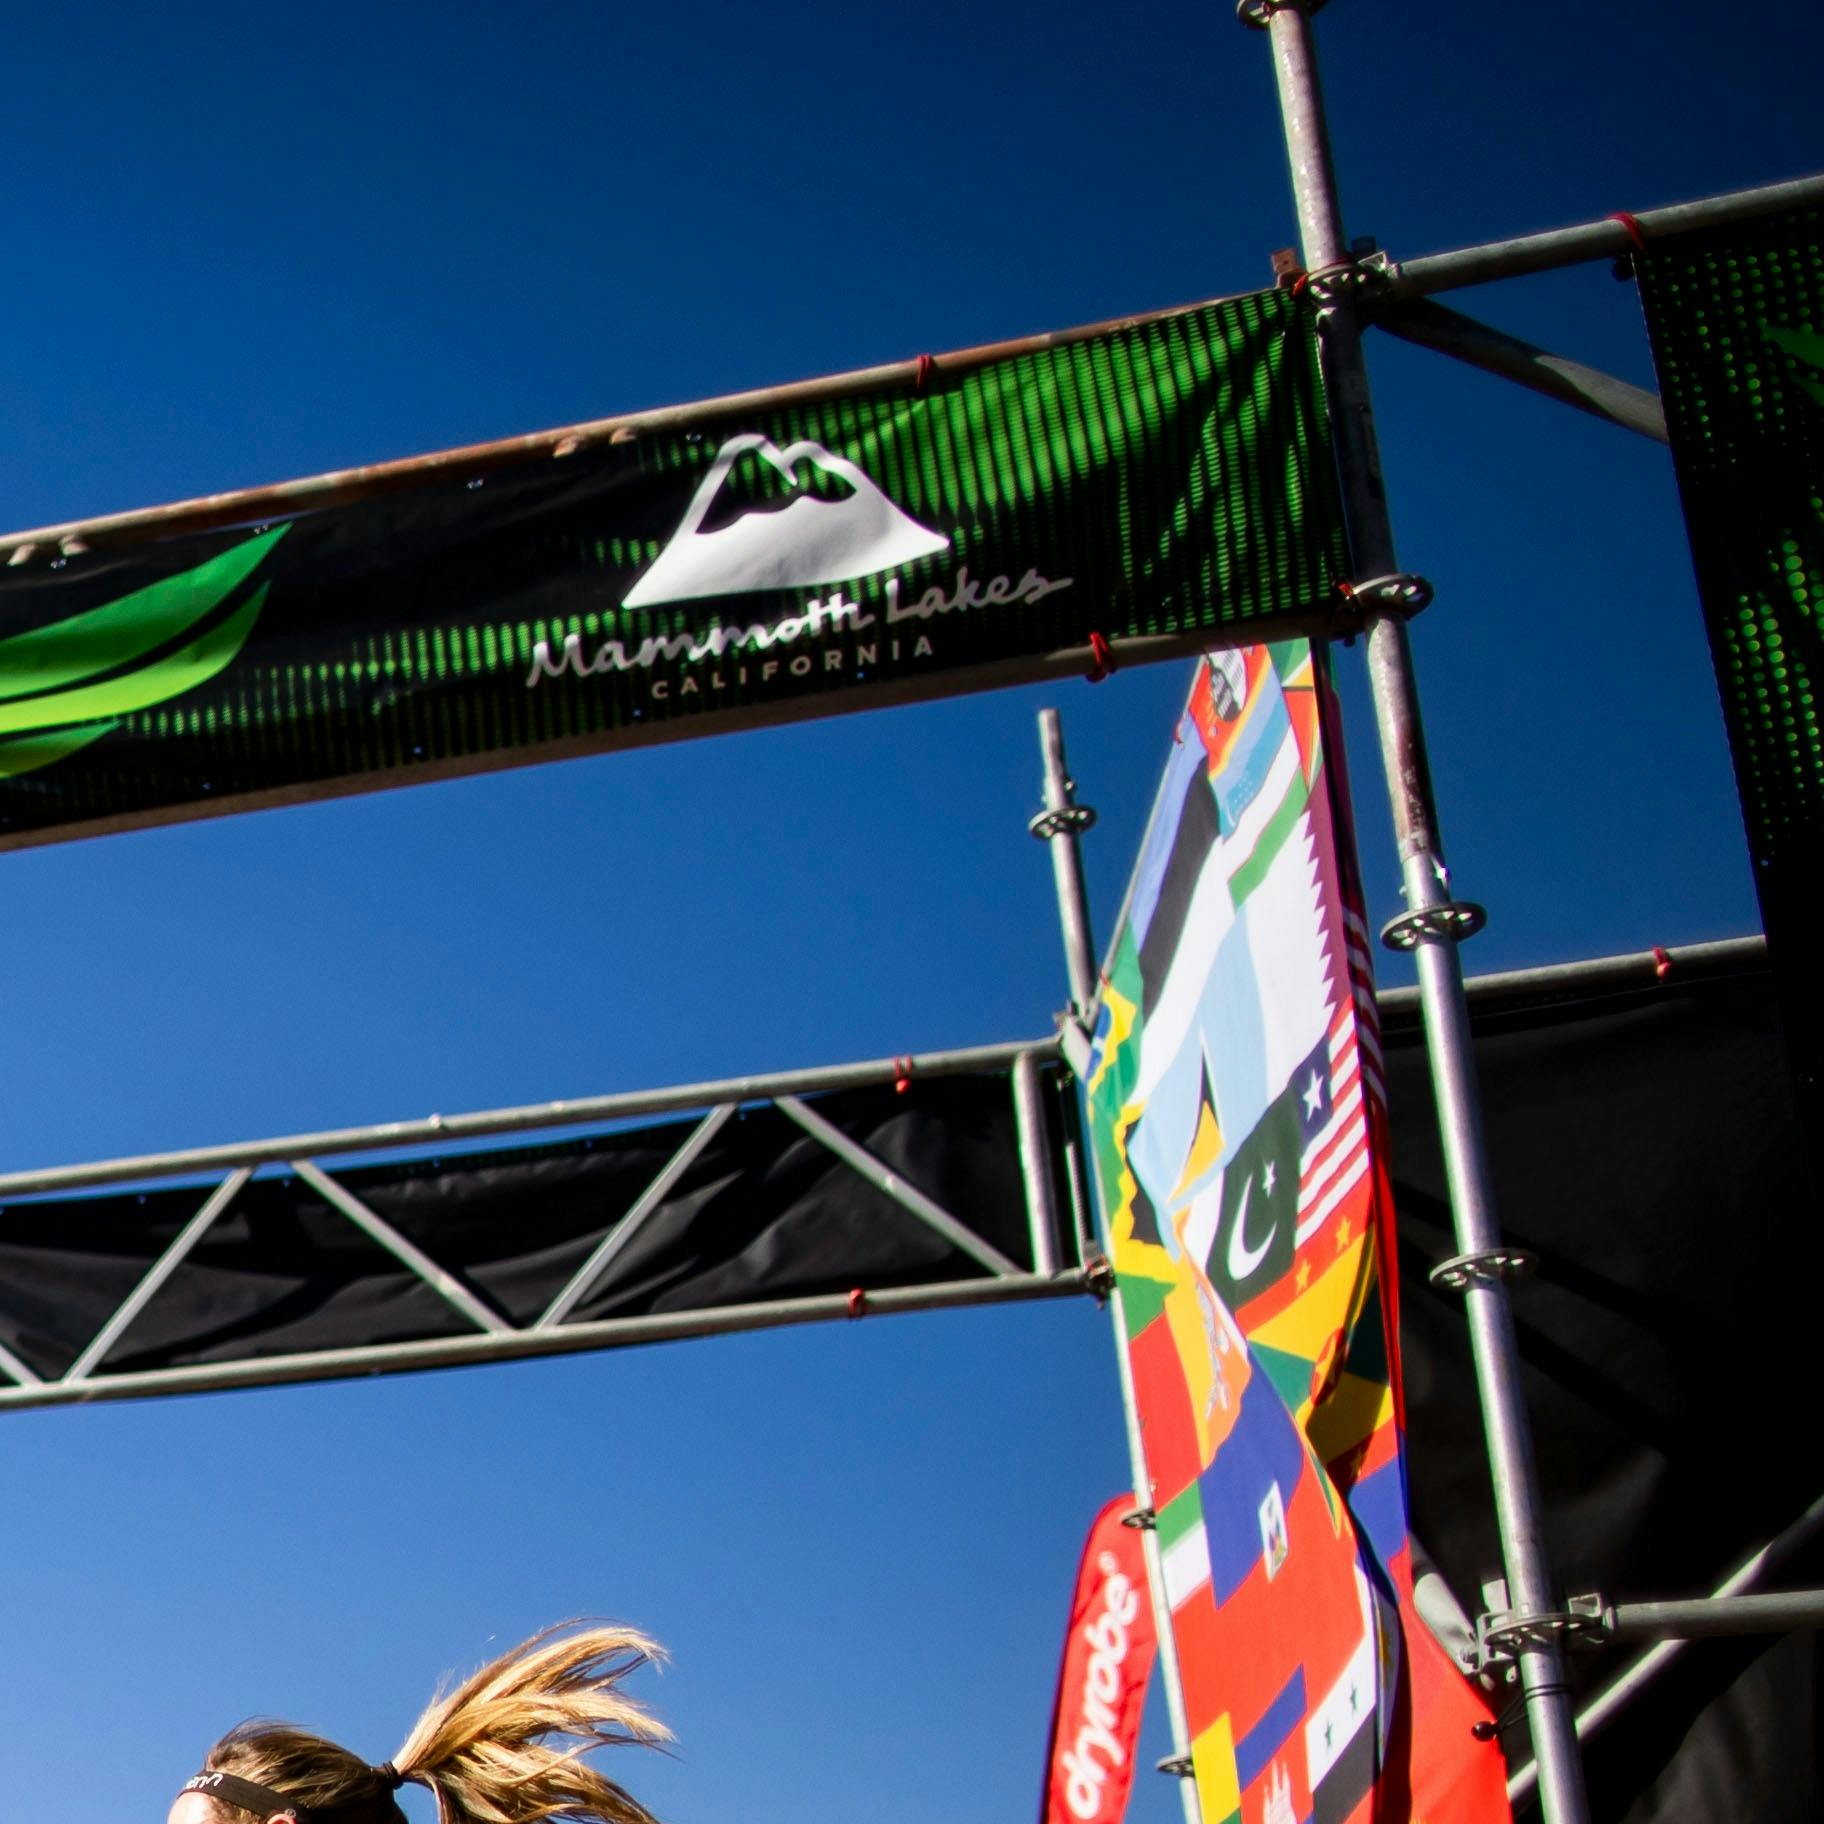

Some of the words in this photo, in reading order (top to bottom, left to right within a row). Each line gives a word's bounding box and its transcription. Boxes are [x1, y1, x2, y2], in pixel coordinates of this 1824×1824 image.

[526, 592, 876, 687] Mammoth
[885, 567, 1073, 625] Lakes
[652, 635, 933, 700] CALIFORNIA
